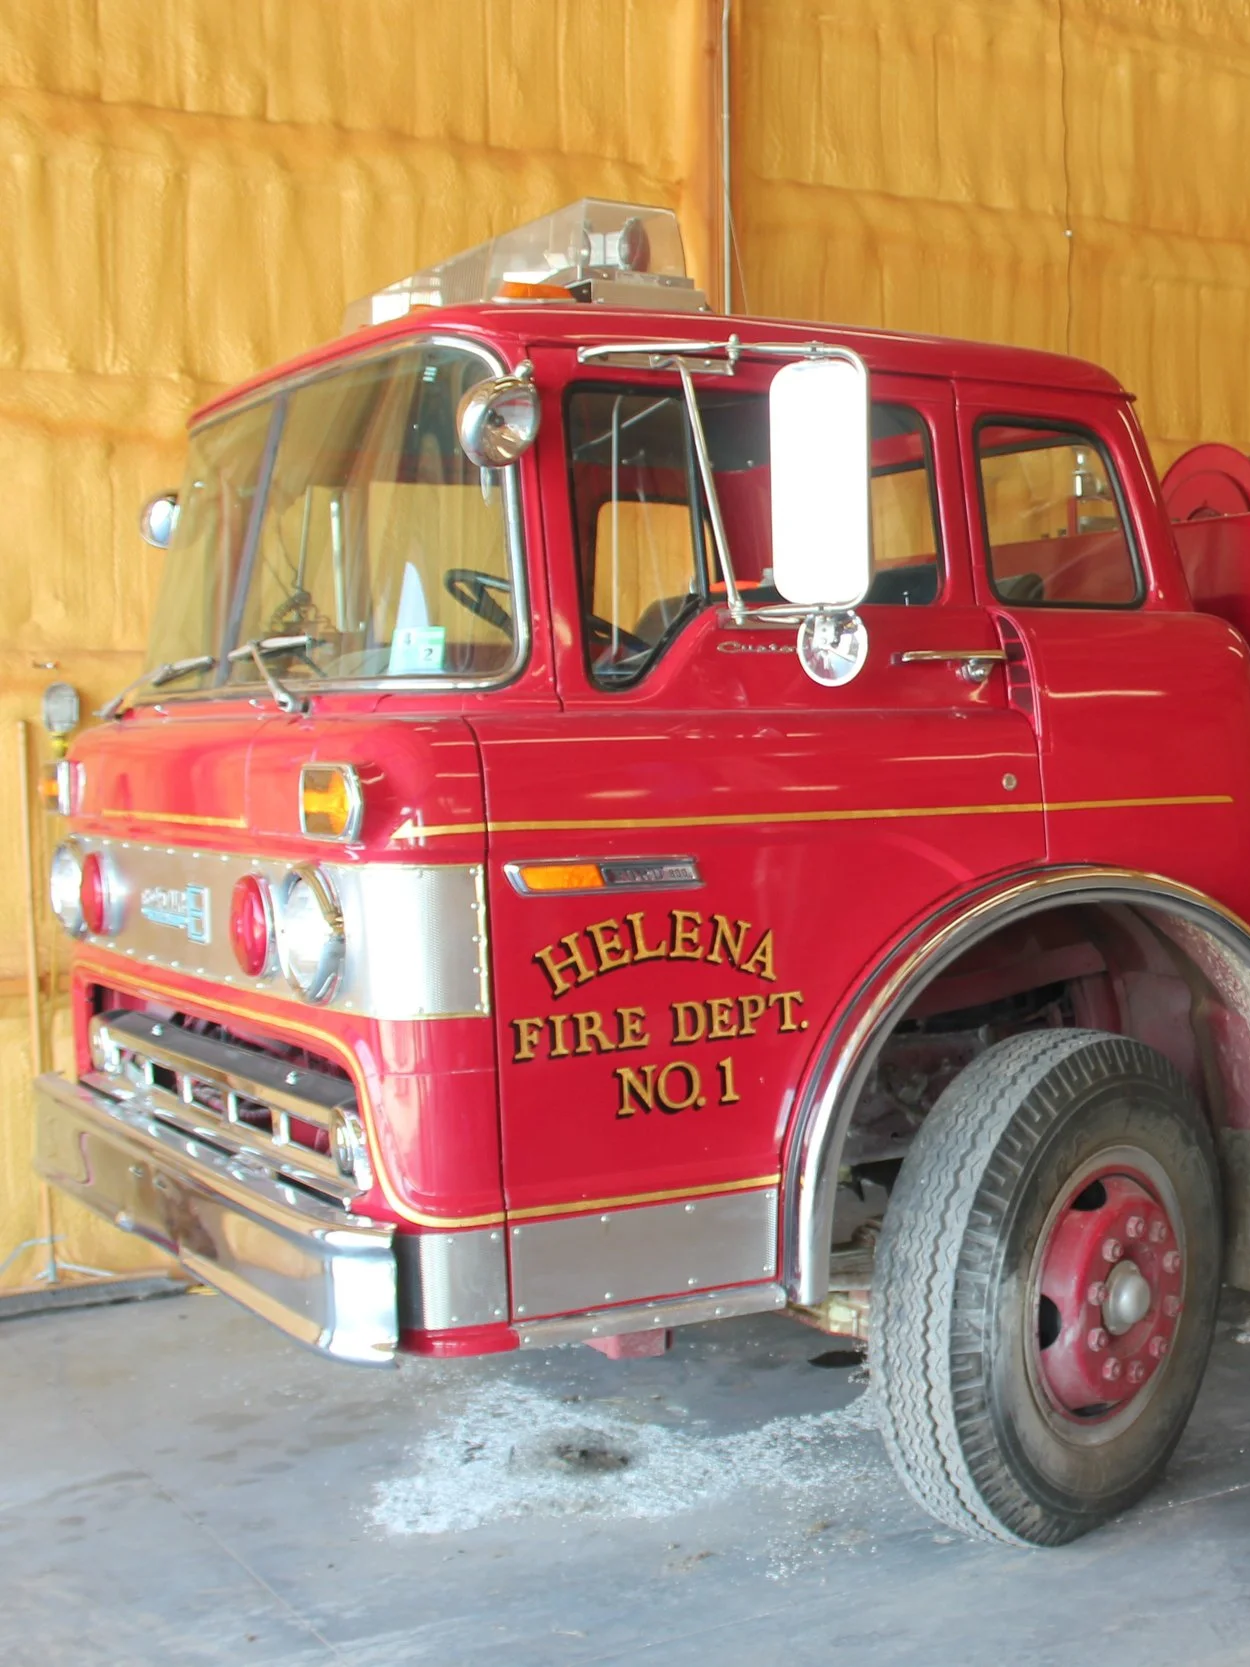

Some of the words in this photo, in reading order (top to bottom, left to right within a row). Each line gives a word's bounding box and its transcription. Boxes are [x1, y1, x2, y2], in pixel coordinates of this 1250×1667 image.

[716, 641, 798, 654] Custo
[533, 909, 777, 997] HELENA
[512, 1006, 650, 1062] FIRE
[669, 991, 810, 1045] DEPT.
[614, 1060, 707, 1119] NO.
[717, 1056, 741, 1103] 1
